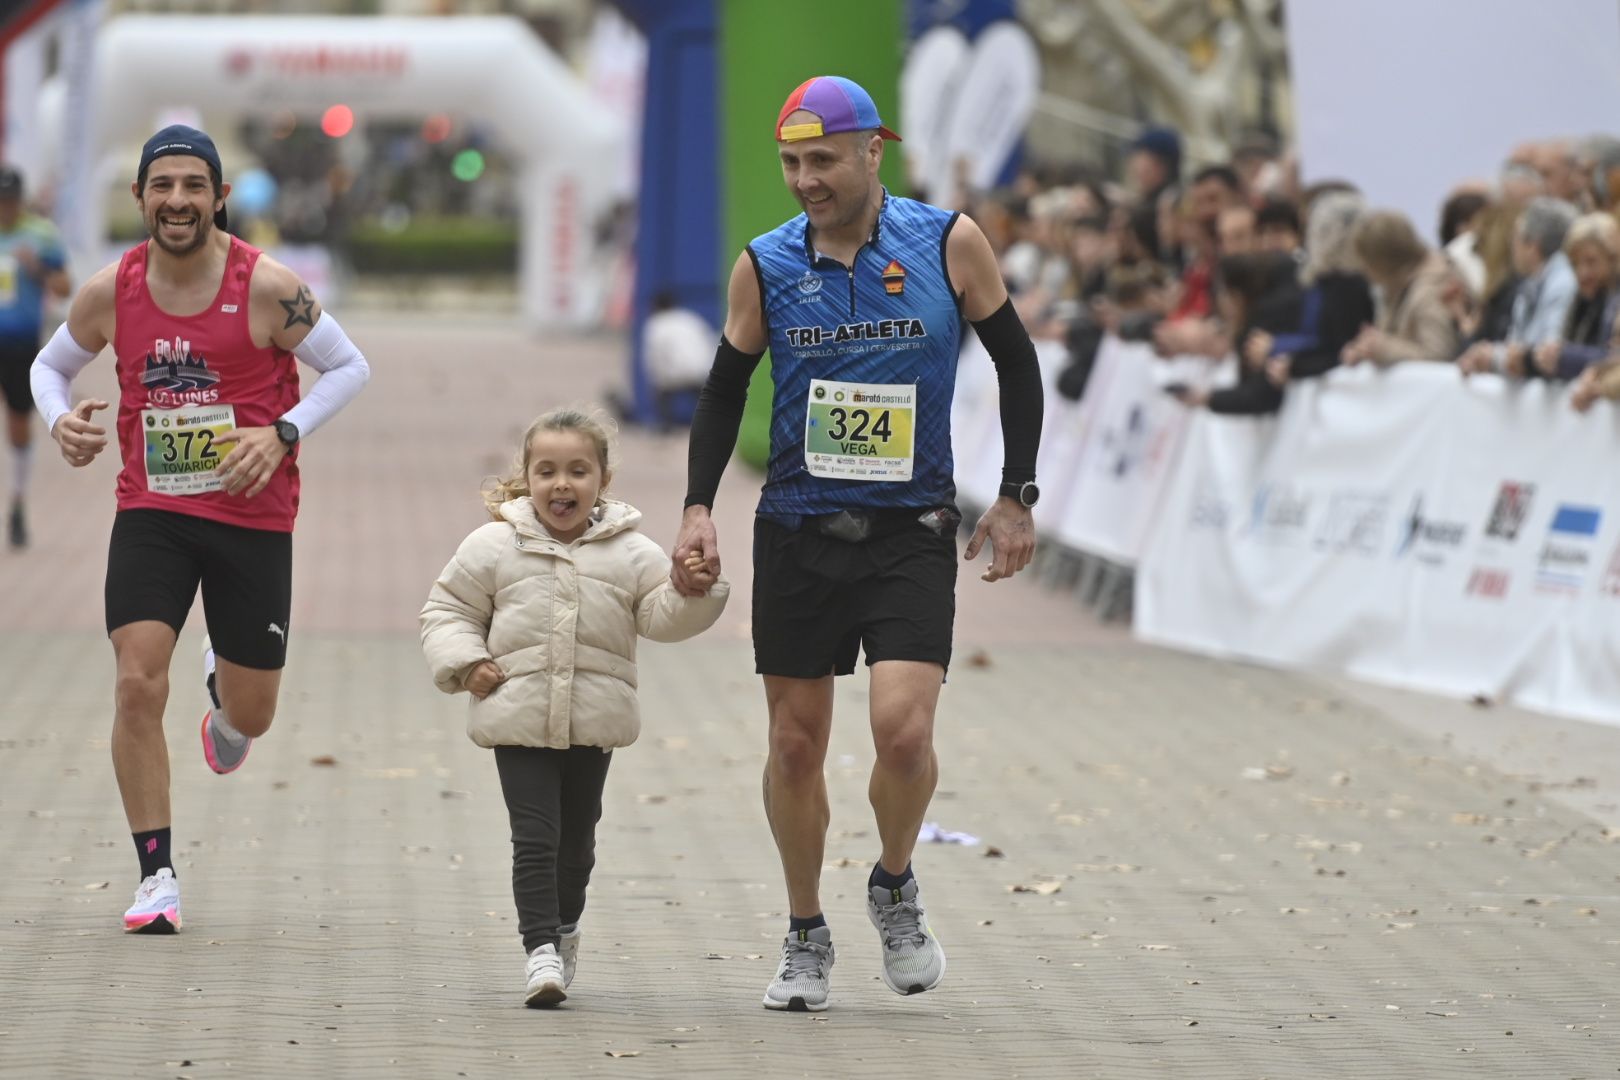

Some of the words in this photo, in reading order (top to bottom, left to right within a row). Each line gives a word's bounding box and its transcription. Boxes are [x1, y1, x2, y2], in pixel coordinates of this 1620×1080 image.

[786, 318, 927, 347] TRI-ATLETA
[172, 389, 218, 405] LUNES
[828, 407, 892, 442] 324
[161, 429, 217, 462] 372
[840, 443, 877, 455] VEGA
[161, 458, 221, 473] TOVARICH
